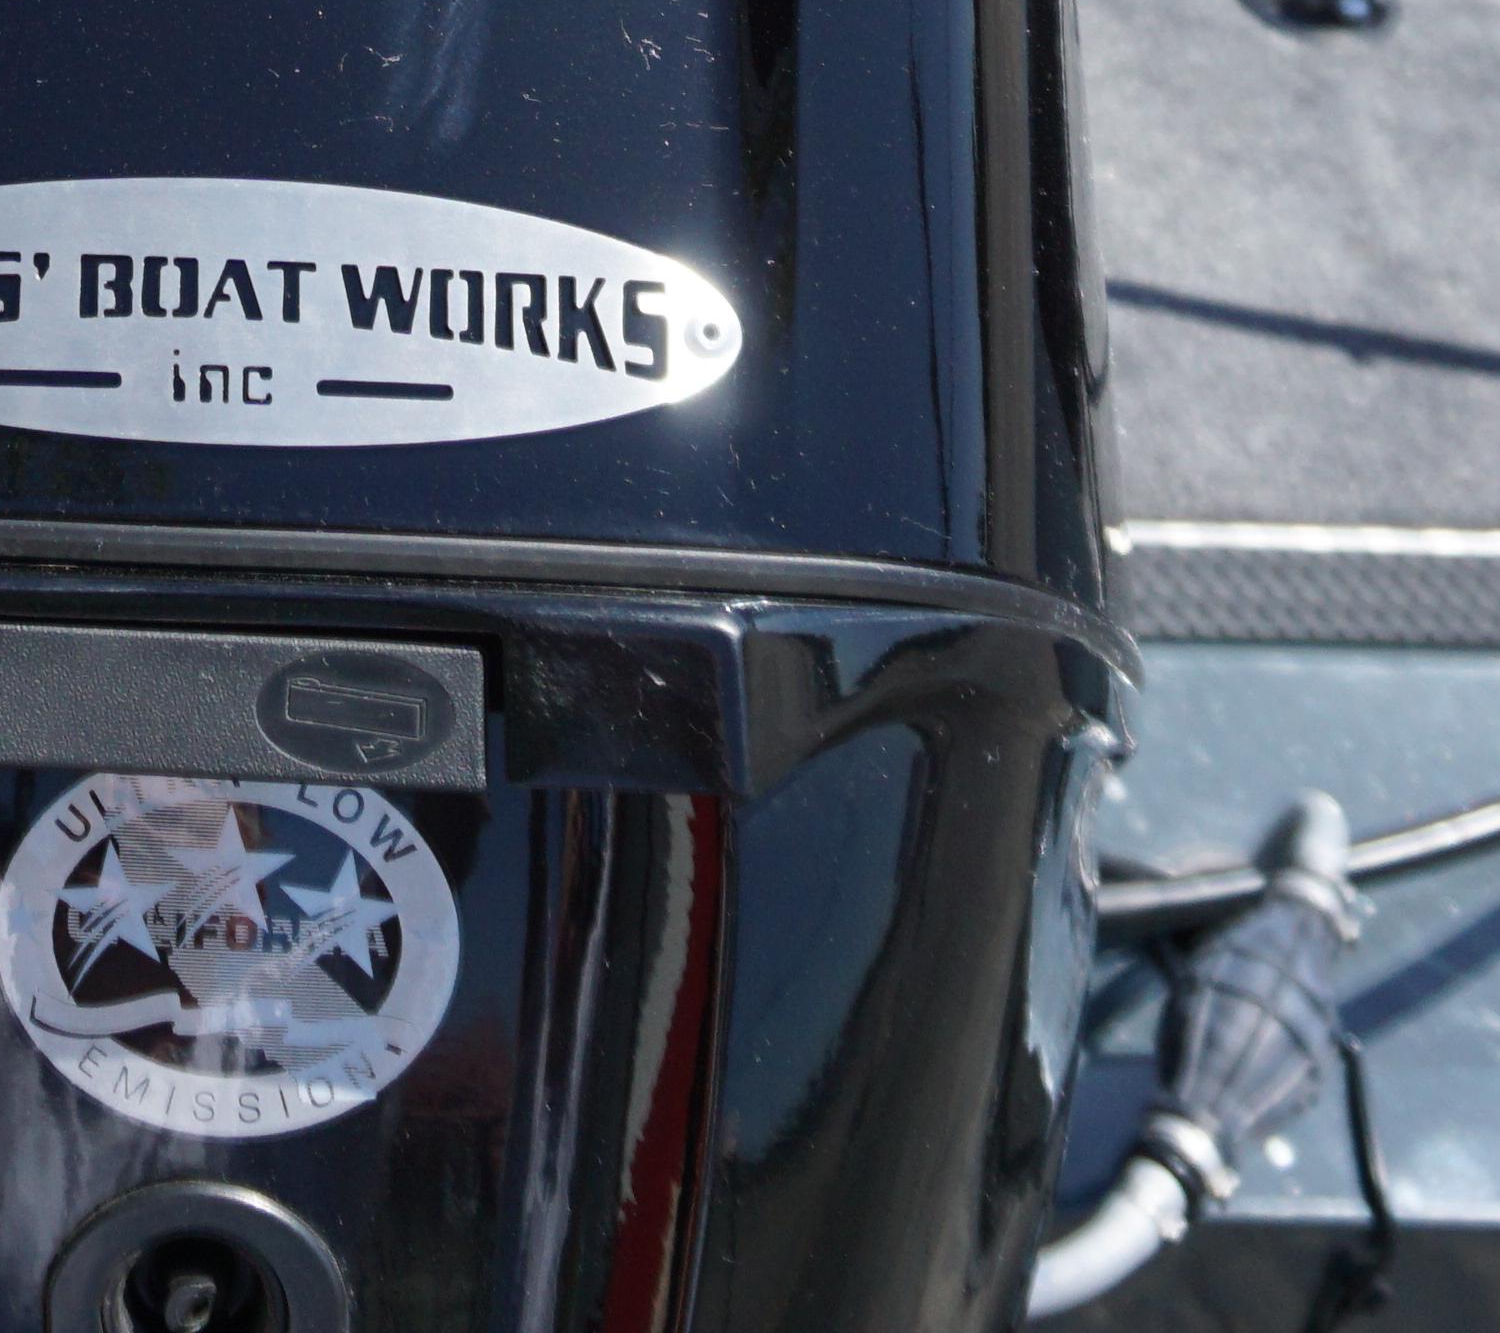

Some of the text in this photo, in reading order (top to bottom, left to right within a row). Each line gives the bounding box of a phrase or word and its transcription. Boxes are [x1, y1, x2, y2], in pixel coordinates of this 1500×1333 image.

[78, 253, 317, 325] BOAT
[341, 263, 668, 381] WORKS
[171, 348, 275, 407] inc
[297, 783, 418, 864] LOW
[76, 1043, 378, 1125] EMISSION
